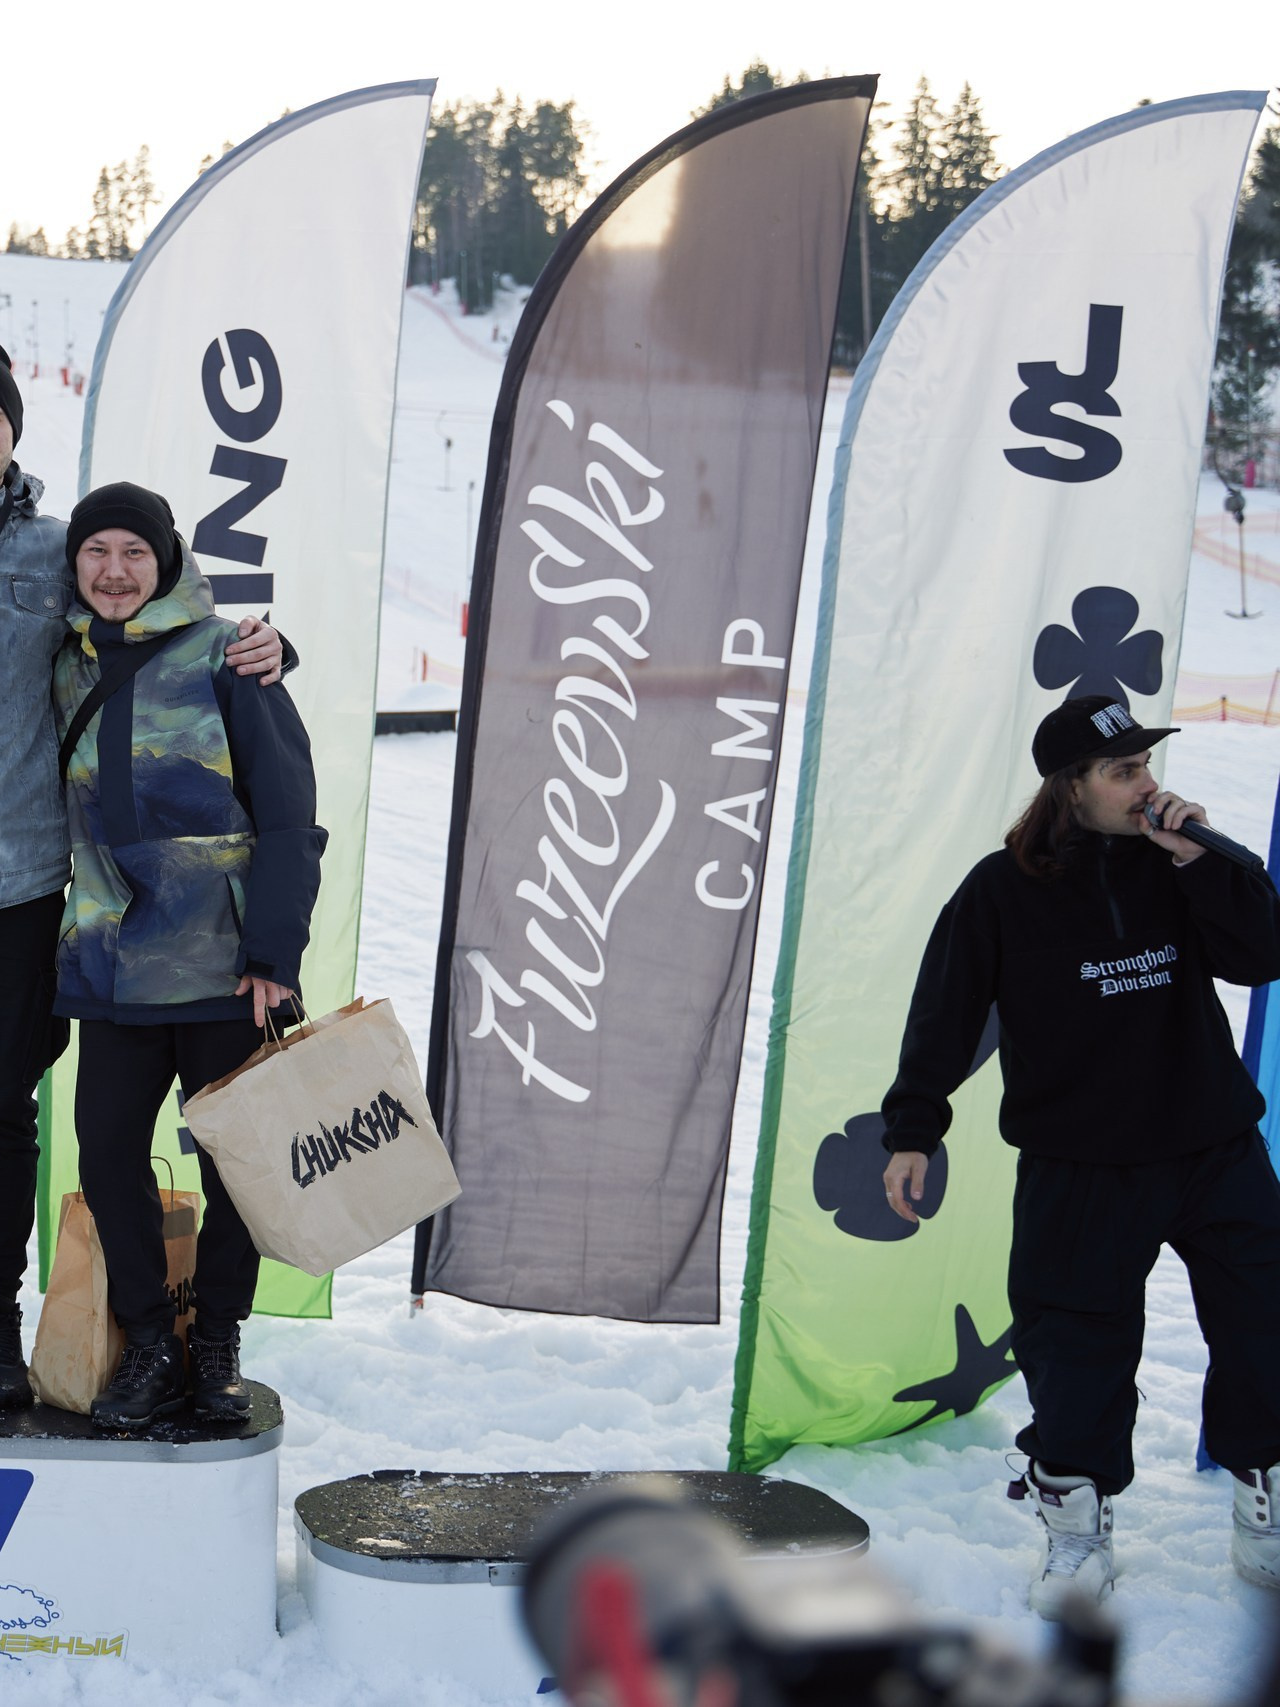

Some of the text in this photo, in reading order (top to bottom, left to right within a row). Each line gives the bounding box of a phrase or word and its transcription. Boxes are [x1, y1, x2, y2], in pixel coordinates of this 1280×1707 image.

[695, 617, 787, 911] CAMP
[1080, 944, 1177, 980] Stronghold
[1098, 969, 1172, 998] Division
